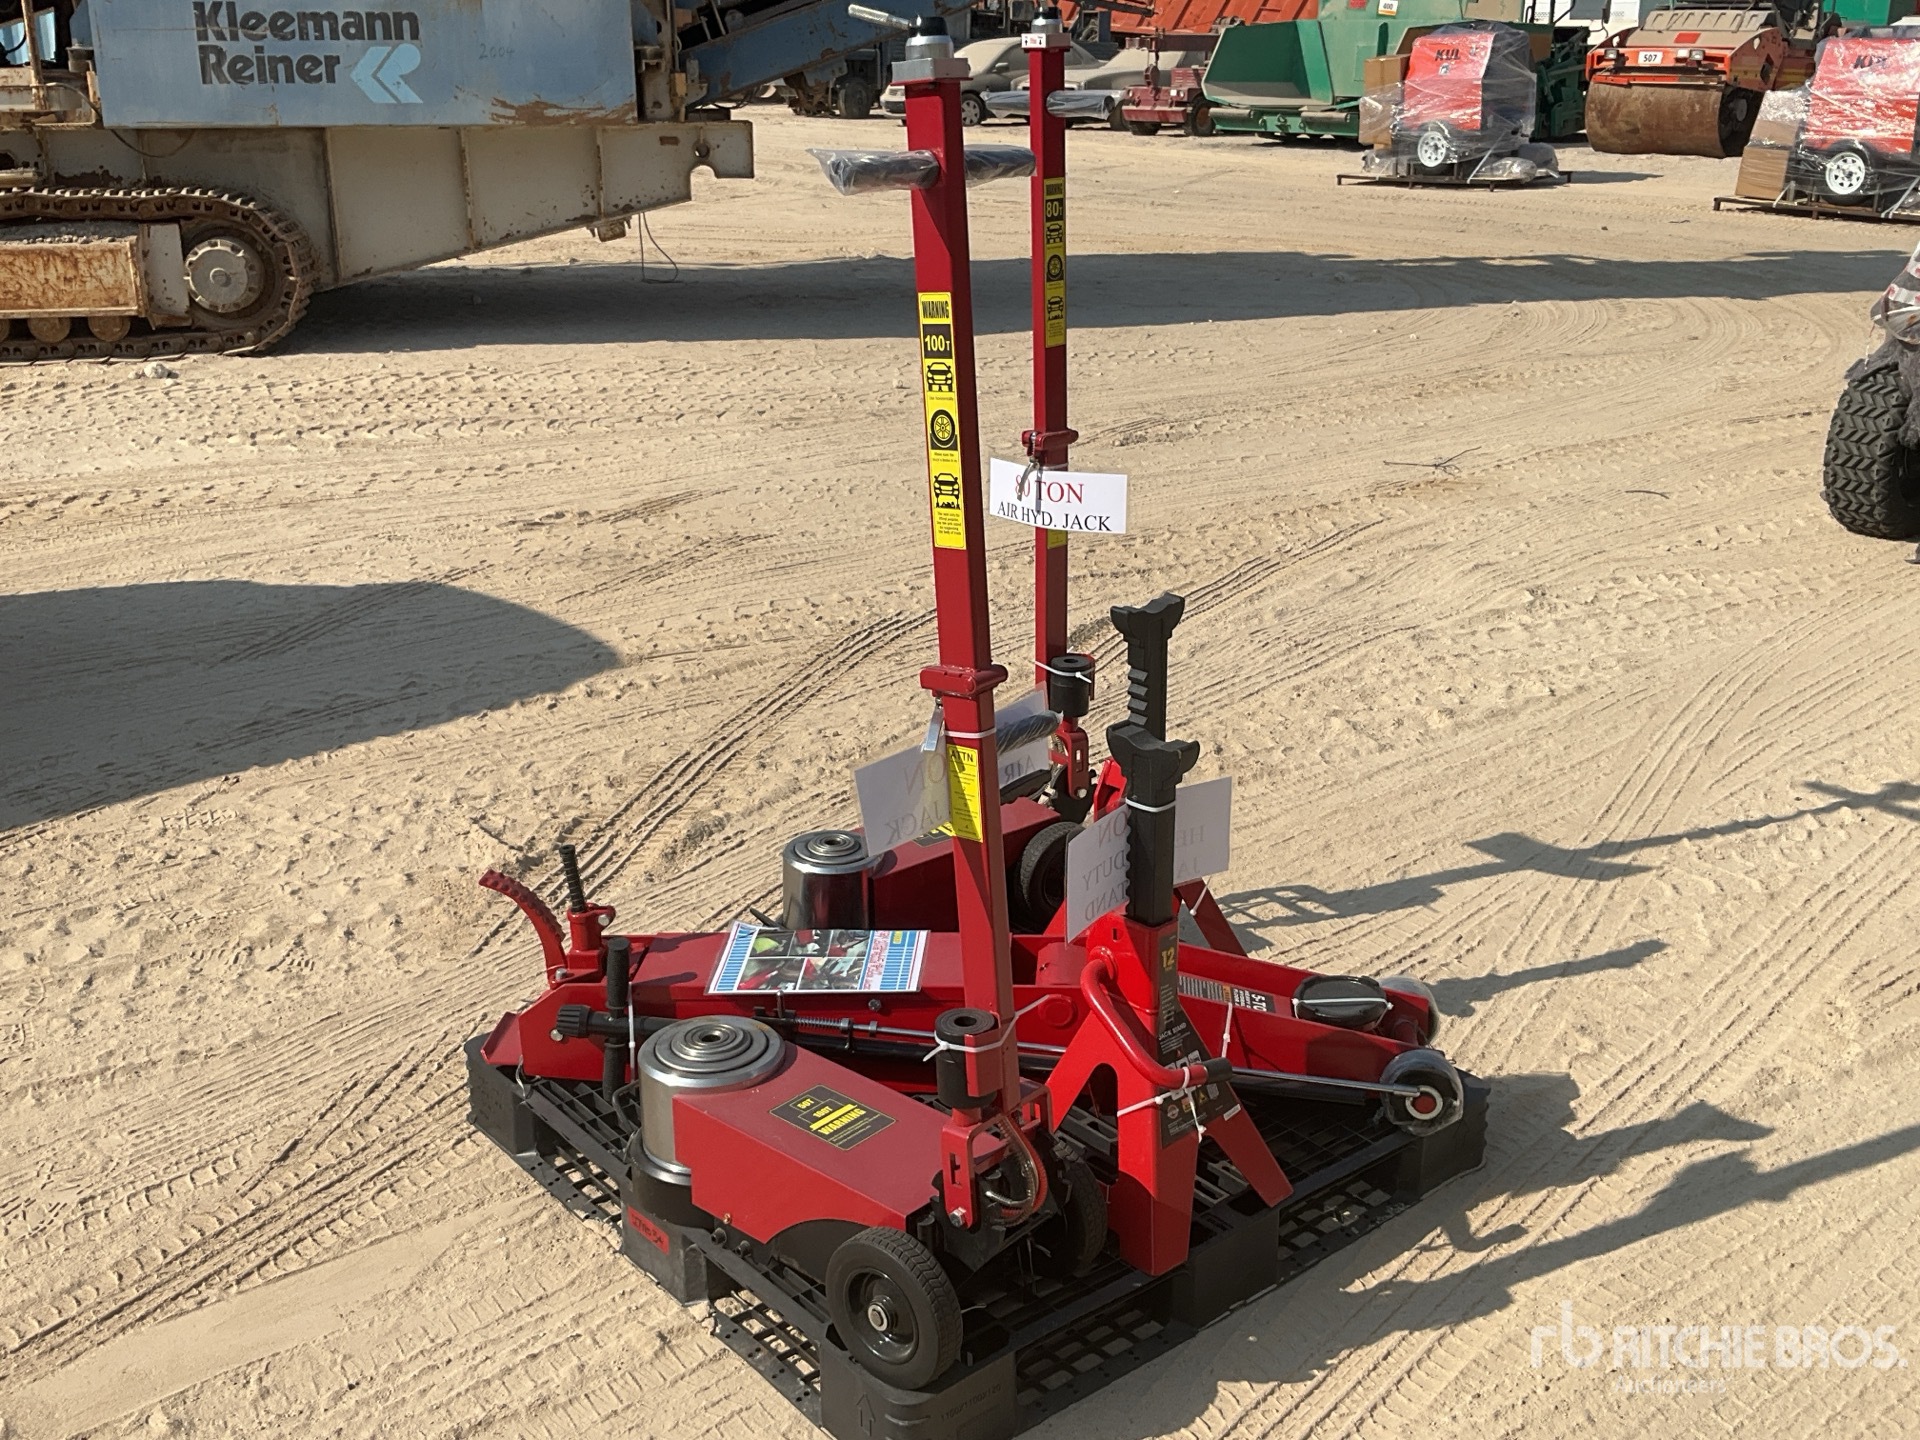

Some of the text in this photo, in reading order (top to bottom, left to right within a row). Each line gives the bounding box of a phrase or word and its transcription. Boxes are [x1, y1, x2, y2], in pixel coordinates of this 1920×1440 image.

[192, 1, 420, 41] Kleemann
[197, 45, 341, 84] Reiner
[1643, 53, 1658, 62] 507
[1046, 201, 1063, 217] 80T
[922, 300, 950, 319] WARNING
[924, 335, 951, 351] 100T
[1034, 480, 1085, 505] TON
[997, 501, 1112, 532] AIR HYD. JACK
[950, 750, 974, 763] ATTN
[1161, 946, 1175, 968] 12
[817, 1107, 867, 1136] WARNING
